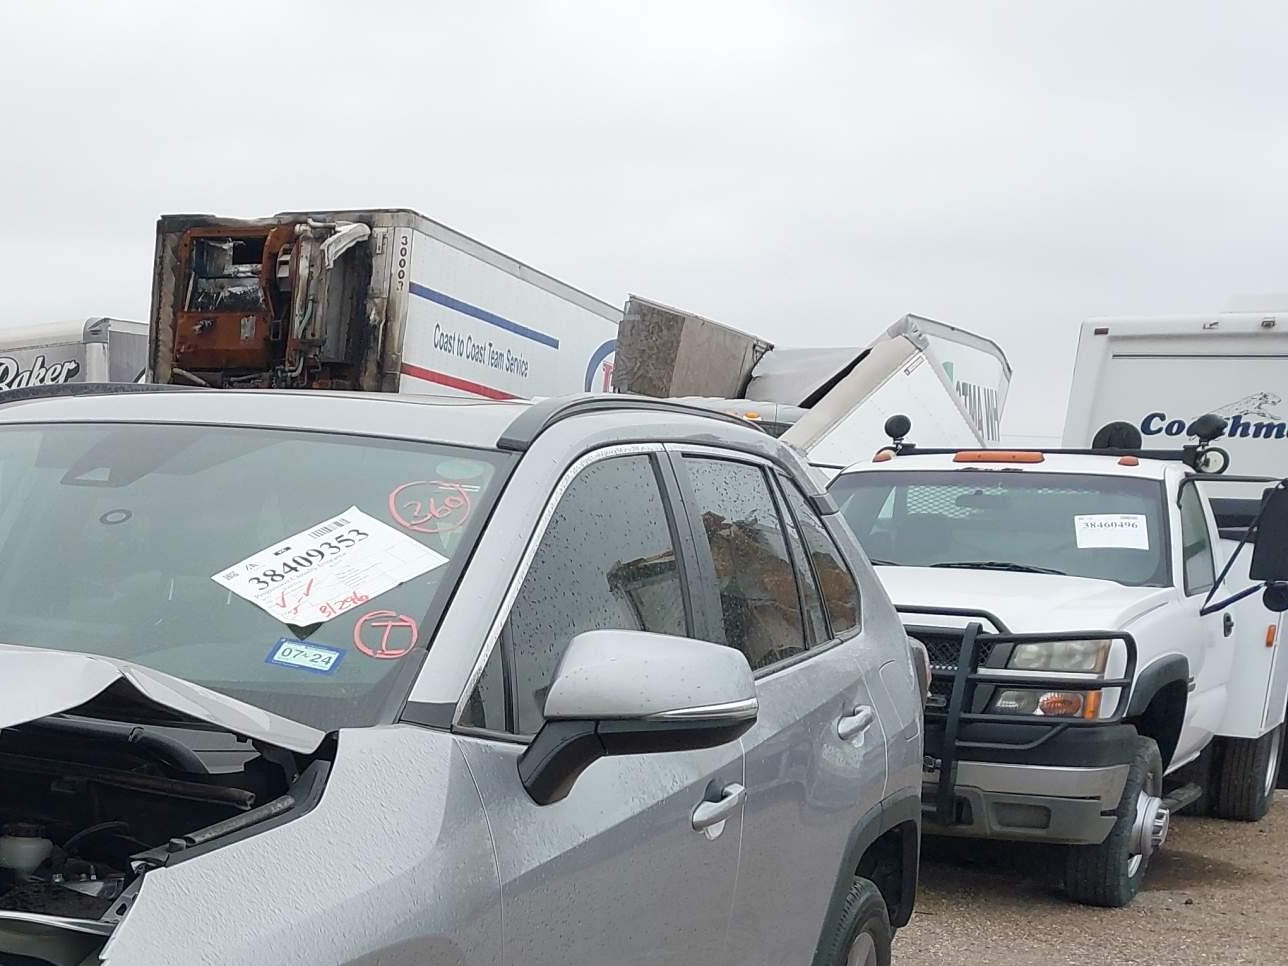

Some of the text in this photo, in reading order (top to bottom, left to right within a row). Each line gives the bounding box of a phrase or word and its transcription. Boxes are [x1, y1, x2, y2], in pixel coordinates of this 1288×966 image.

[433, 322, 529, 378] Coast to Coast Team Service
[1140, 411, 1288, 439] Cohm
[248, 528, 369, 591] 38409353
